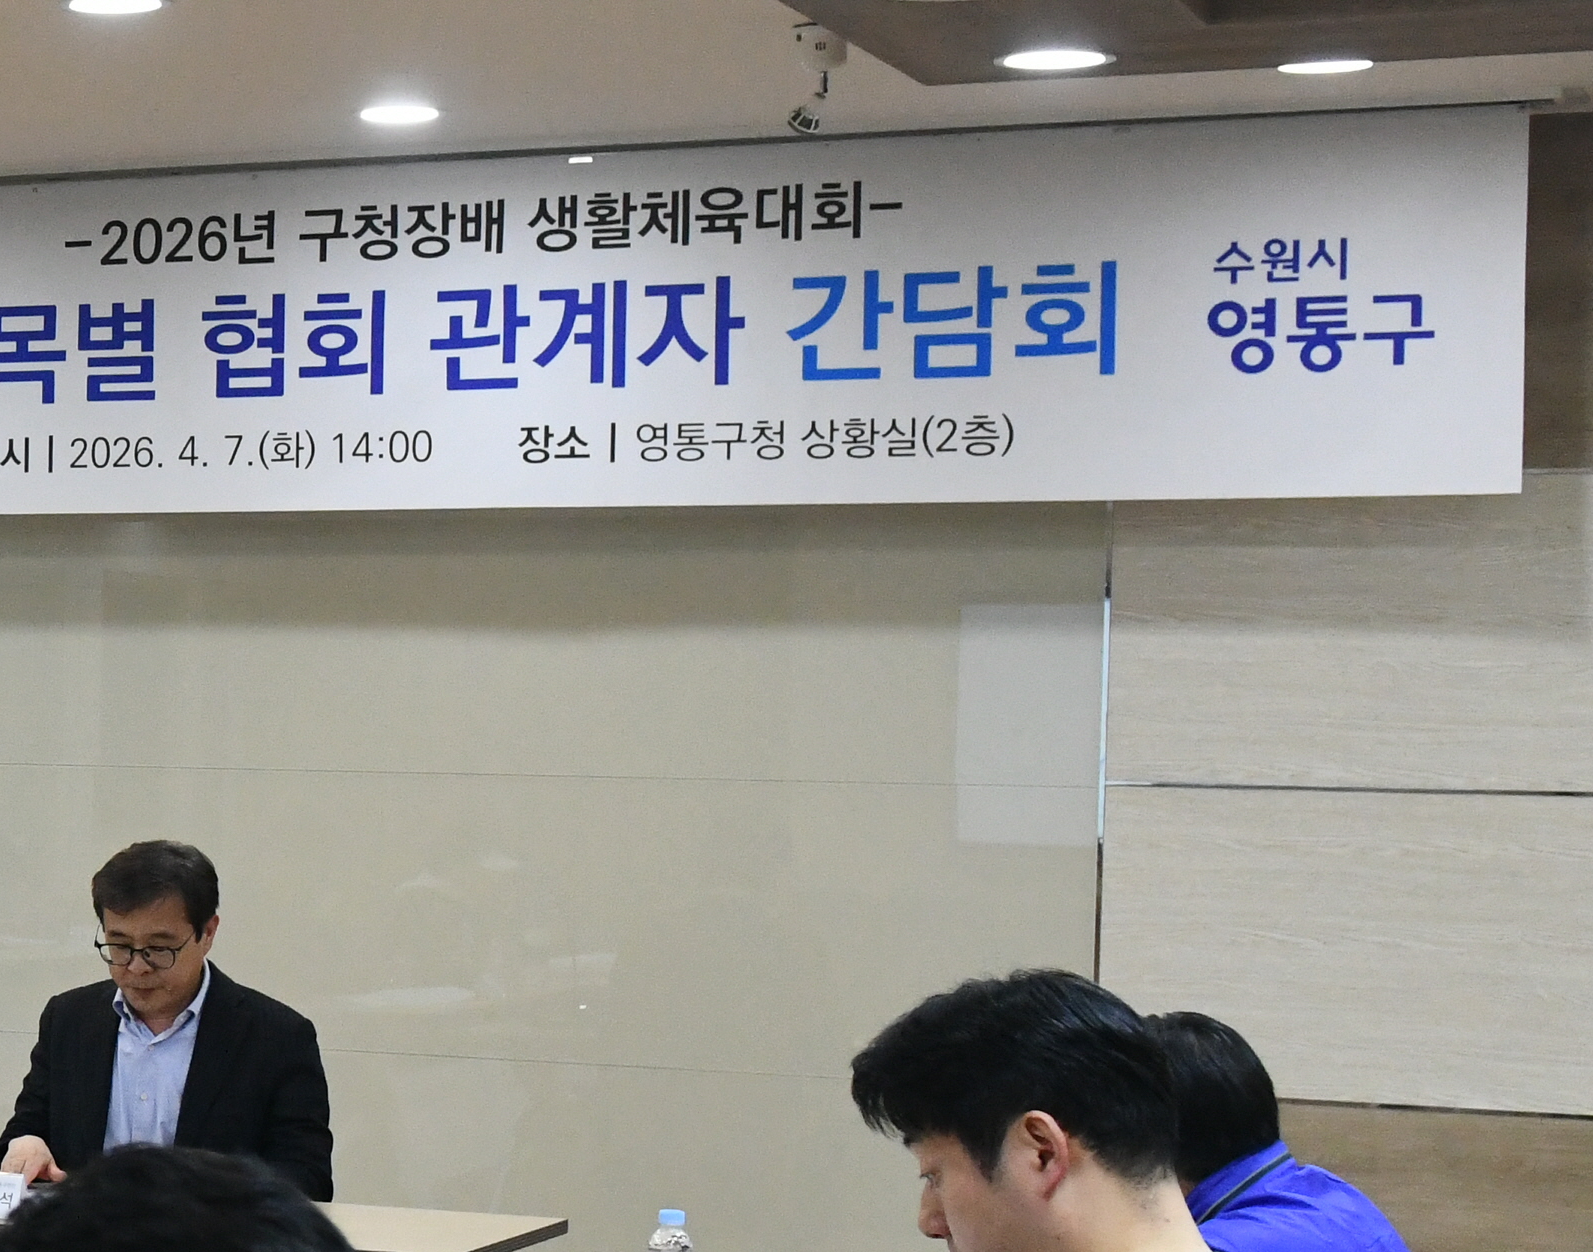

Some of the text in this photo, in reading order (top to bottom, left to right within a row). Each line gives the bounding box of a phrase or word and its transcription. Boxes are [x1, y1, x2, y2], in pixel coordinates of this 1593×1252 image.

[298, 198, 506, 262] 구청장배
[1213, 236, 1350, 284] 수원시
[201, 289, 386, 399] 협회
[429, 275, 746, 391] 관계자
[785, 260, 1118, 381] 간담회
[1206, 293, 1436, 374] 영통구
[69, 436, 164, 470] 2026.
[331, 429, 433, 465] 14:00
[517, 424, 592, 464] 장소
[635, 418, 786, 462] 영통구청
[799, 412, 1016, 460] 상황실(2층)
